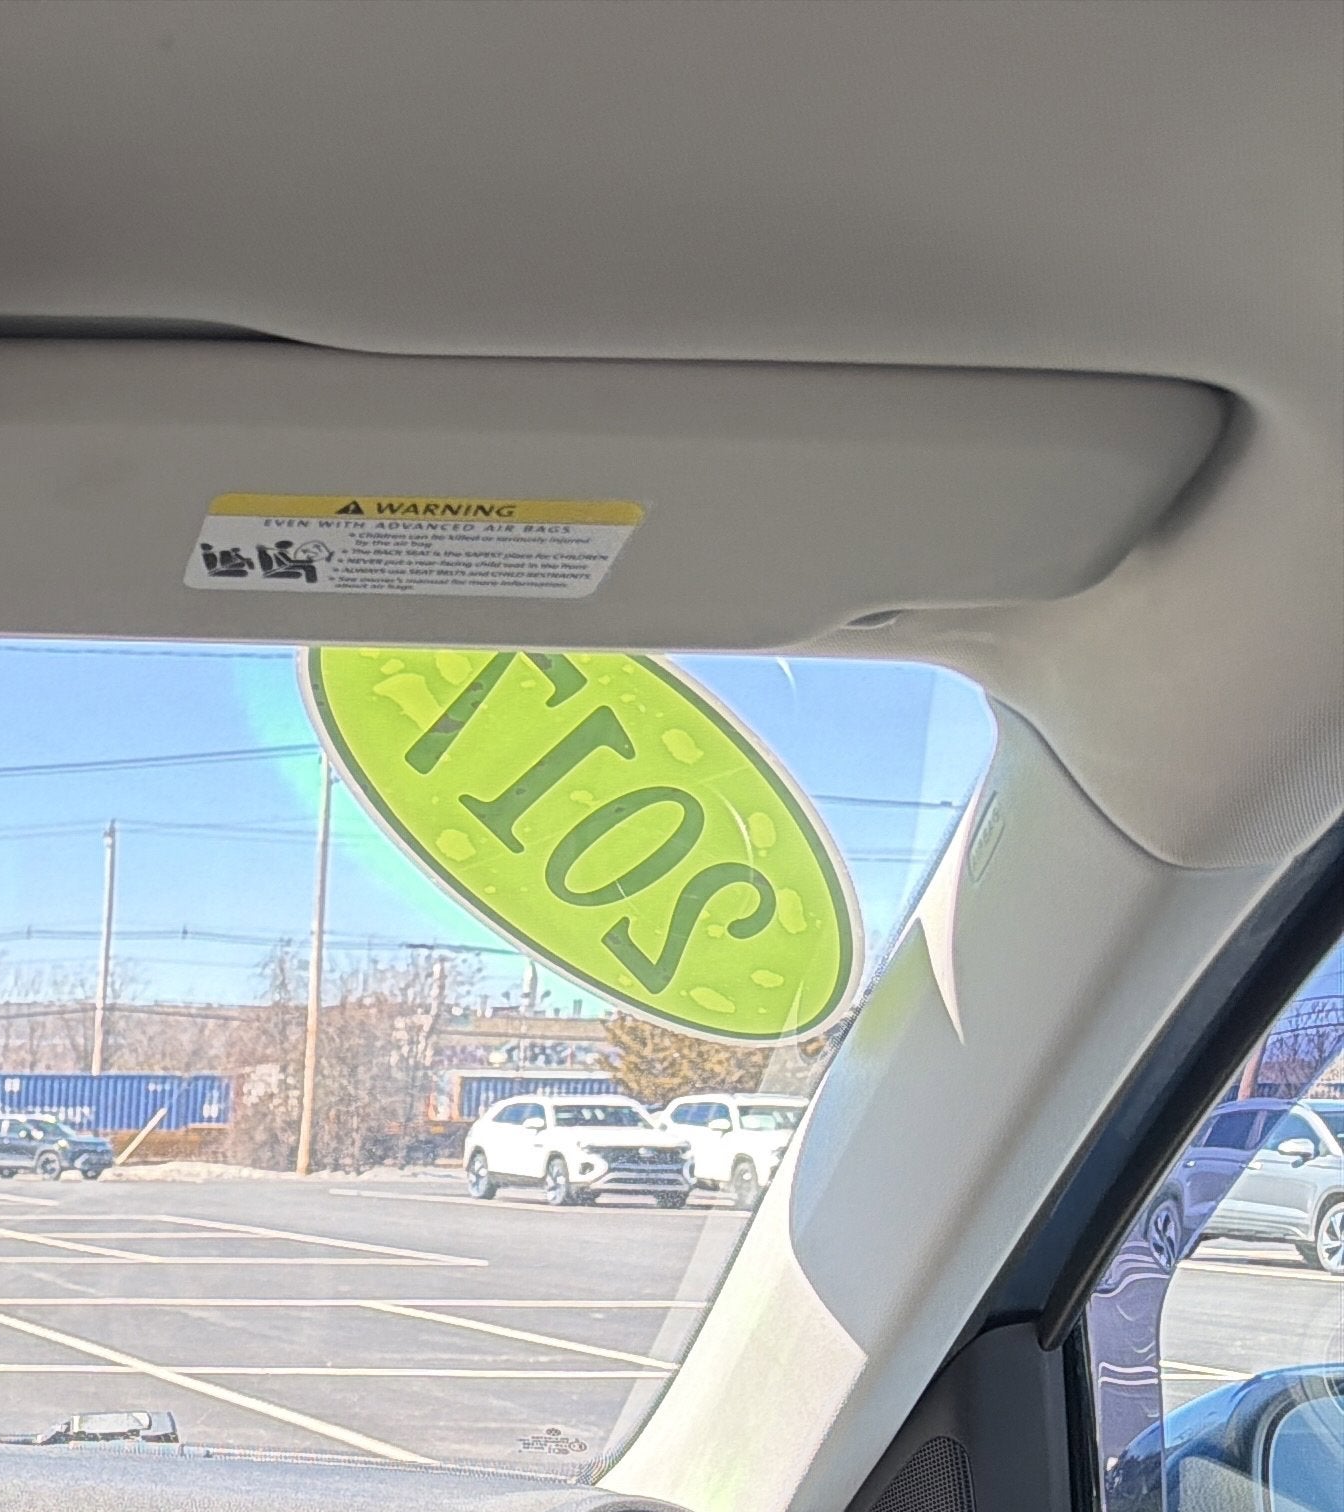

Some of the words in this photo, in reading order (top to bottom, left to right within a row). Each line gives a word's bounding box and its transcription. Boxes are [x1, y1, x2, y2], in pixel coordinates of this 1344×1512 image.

[376, 502, 516, 517] WARNING
[263, 519, 310, 527] EVEN
[318, 520, 366, 529] WITH
[374, 521, 475, 532] ADVANCED
[483, 524, 515, 533] AIR
[523, 525, 571, 534] BAGS
